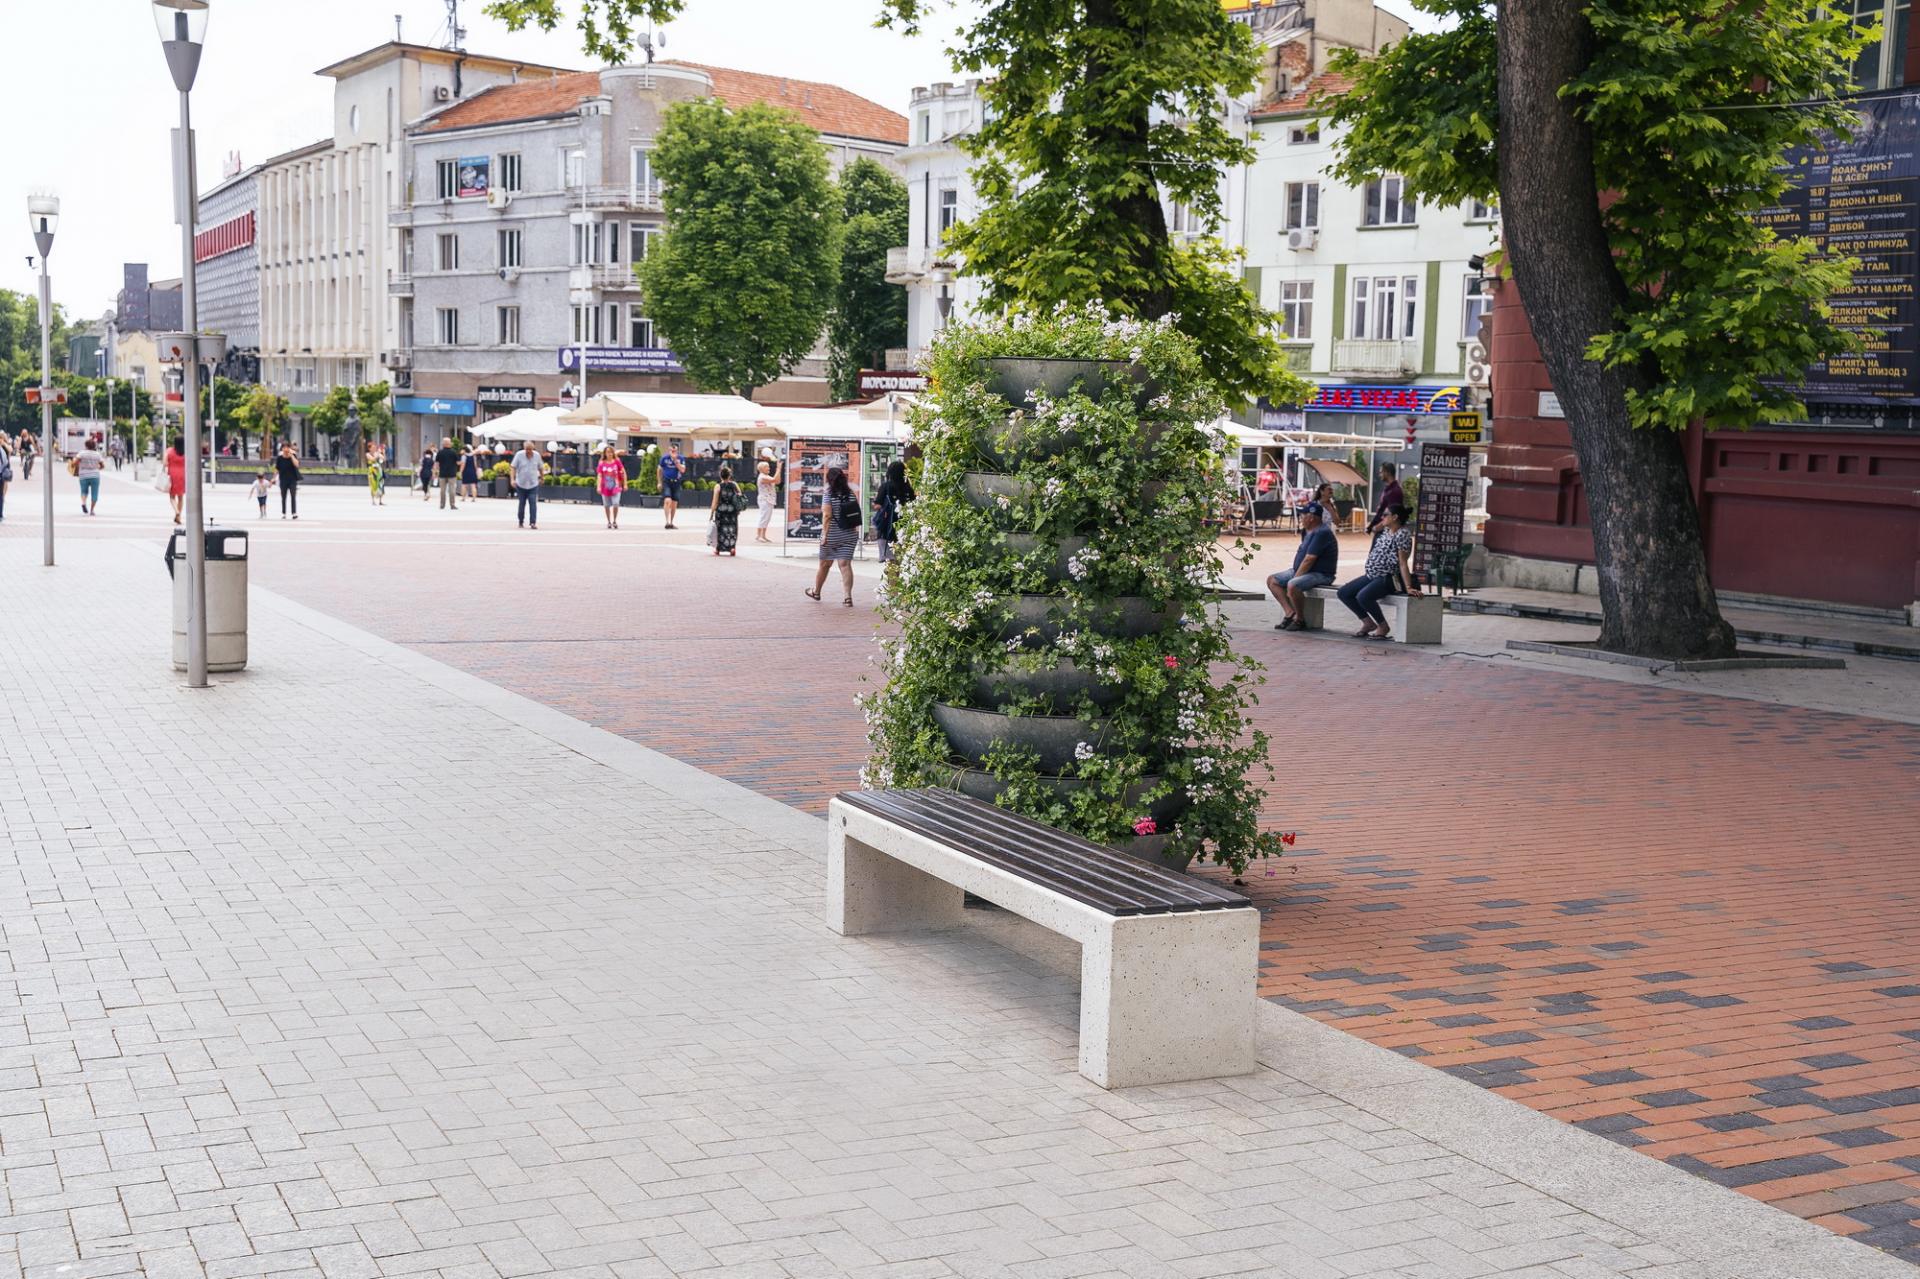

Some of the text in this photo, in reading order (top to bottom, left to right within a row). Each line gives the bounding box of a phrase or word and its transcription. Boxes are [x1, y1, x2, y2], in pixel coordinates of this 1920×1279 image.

[1860, 161, 1893, 172] СИНЪТ
[1831, 172, 1868, 183] НА АСЕН
[1829, 197, 1867, 208] ДИДОНА
[1869, 196, 1875, 204] И
[1877, 192, 1902, 203] ЕНЕЙ
[1774, 213, 1800, 223] МАРТА
[1829, 220, 1865, 233] ДВУБОЙ
[1853, 241, 1866, 249] ПО
[1867, 238, 1909, 249] ПРИНУДА
[1867, 262, 1890, 271] ГАЛА
[1871, 285, 1881, 293] НА
[1883, 284, 1913, 293] МАРТА
[1829, 315, 1868, 324] ГЛАСОВЕ
[1829, 359, 1866, 368] МАГИЯТА
[1868, 359, 1879, 368] НА
[1829, 367, 1861, 376] КИНОТО
[1867, 367, 1900, 378] ЕПИЗОД
[1902, 367, 1907, 377] 3
[861, 376, 898, 390] МОРСКО
[1322, 388, 1419, 409] LAS VEGAS
[1454, 433, 1476, 442] OPEN
[1424, 447, 1445, 455] Office
[1423, 455, 1467, 468] CHANGE
